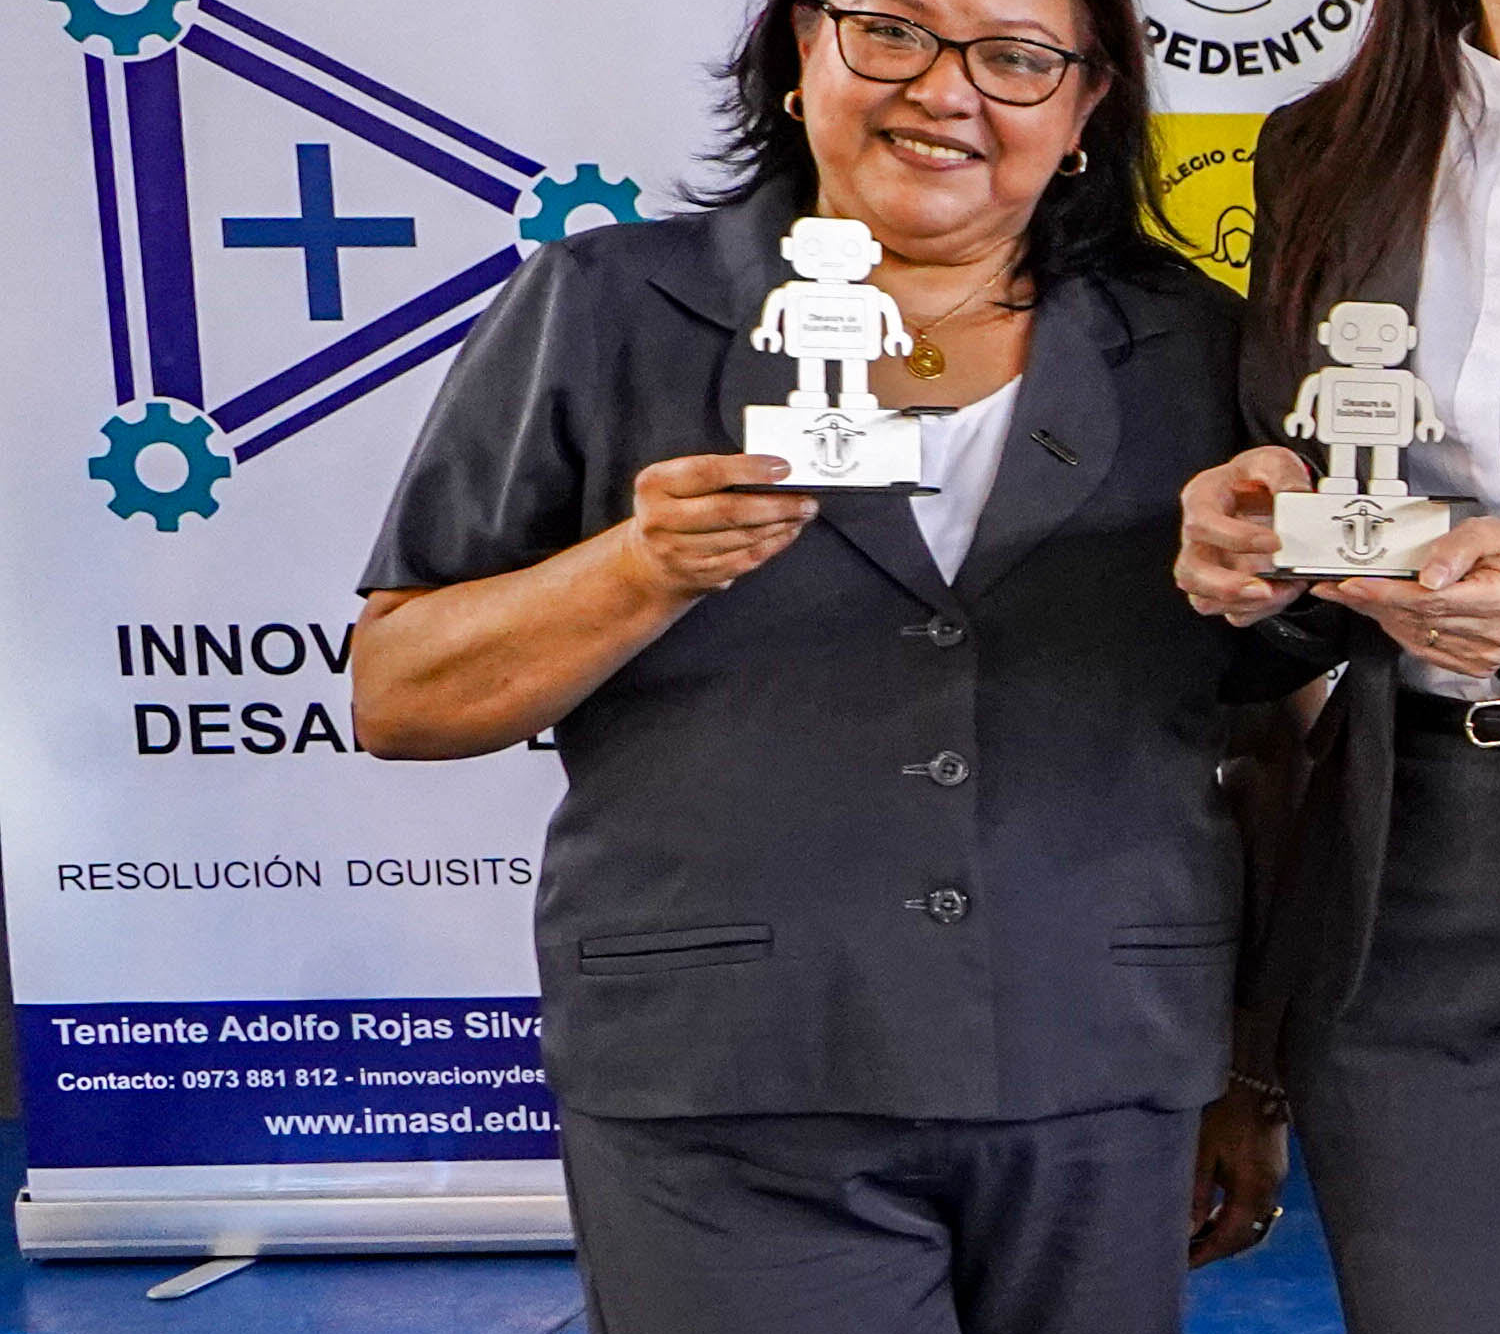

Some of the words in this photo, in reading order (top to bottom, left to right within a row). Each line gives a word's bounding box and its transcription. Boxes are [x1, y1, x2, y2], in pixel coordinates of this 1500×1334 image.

[1160, 149, 1226, 195] OLEGIO
[117, 623, 355, 675] INNOV
[58, 854, 322, 891] RESOLUCIÓN
[347, 857, 533, 887] DGUISITS
[51, 1016, 209, 1045] Teniente
[218, 1013, 340, 1042] Adolfo
[351, 1012, 454, 1046] Rojas
[57, 1072, 175, 1092] Contacto:
[182, 1069, 240, 1089] 0973
[246, 1069, 287, 1088] 881
[295, 1068, 338, 1087] 812
[359, 1065, 546, 1089] innovacionydes
[264, 1105, 561, 1135] www.imasd.edu.
